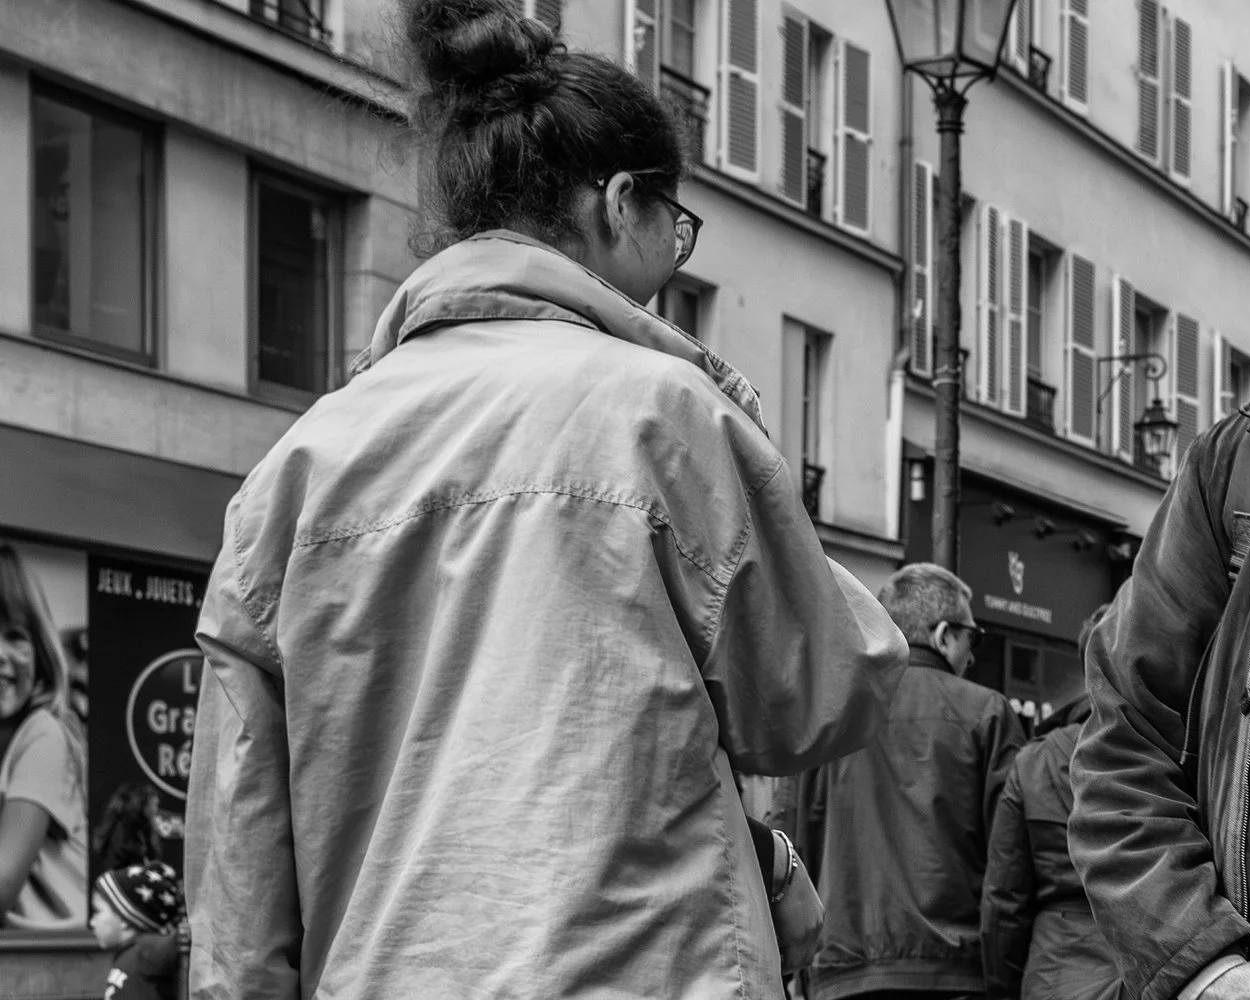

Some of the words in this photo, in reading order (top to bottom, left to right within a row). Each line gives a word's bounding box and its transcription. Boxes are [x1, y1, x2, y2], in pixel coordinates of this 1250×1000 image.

[183, 661, 197, 694] L
[147, 700, 196, 736] Gra
[157, 739, 193, 778] Ré
